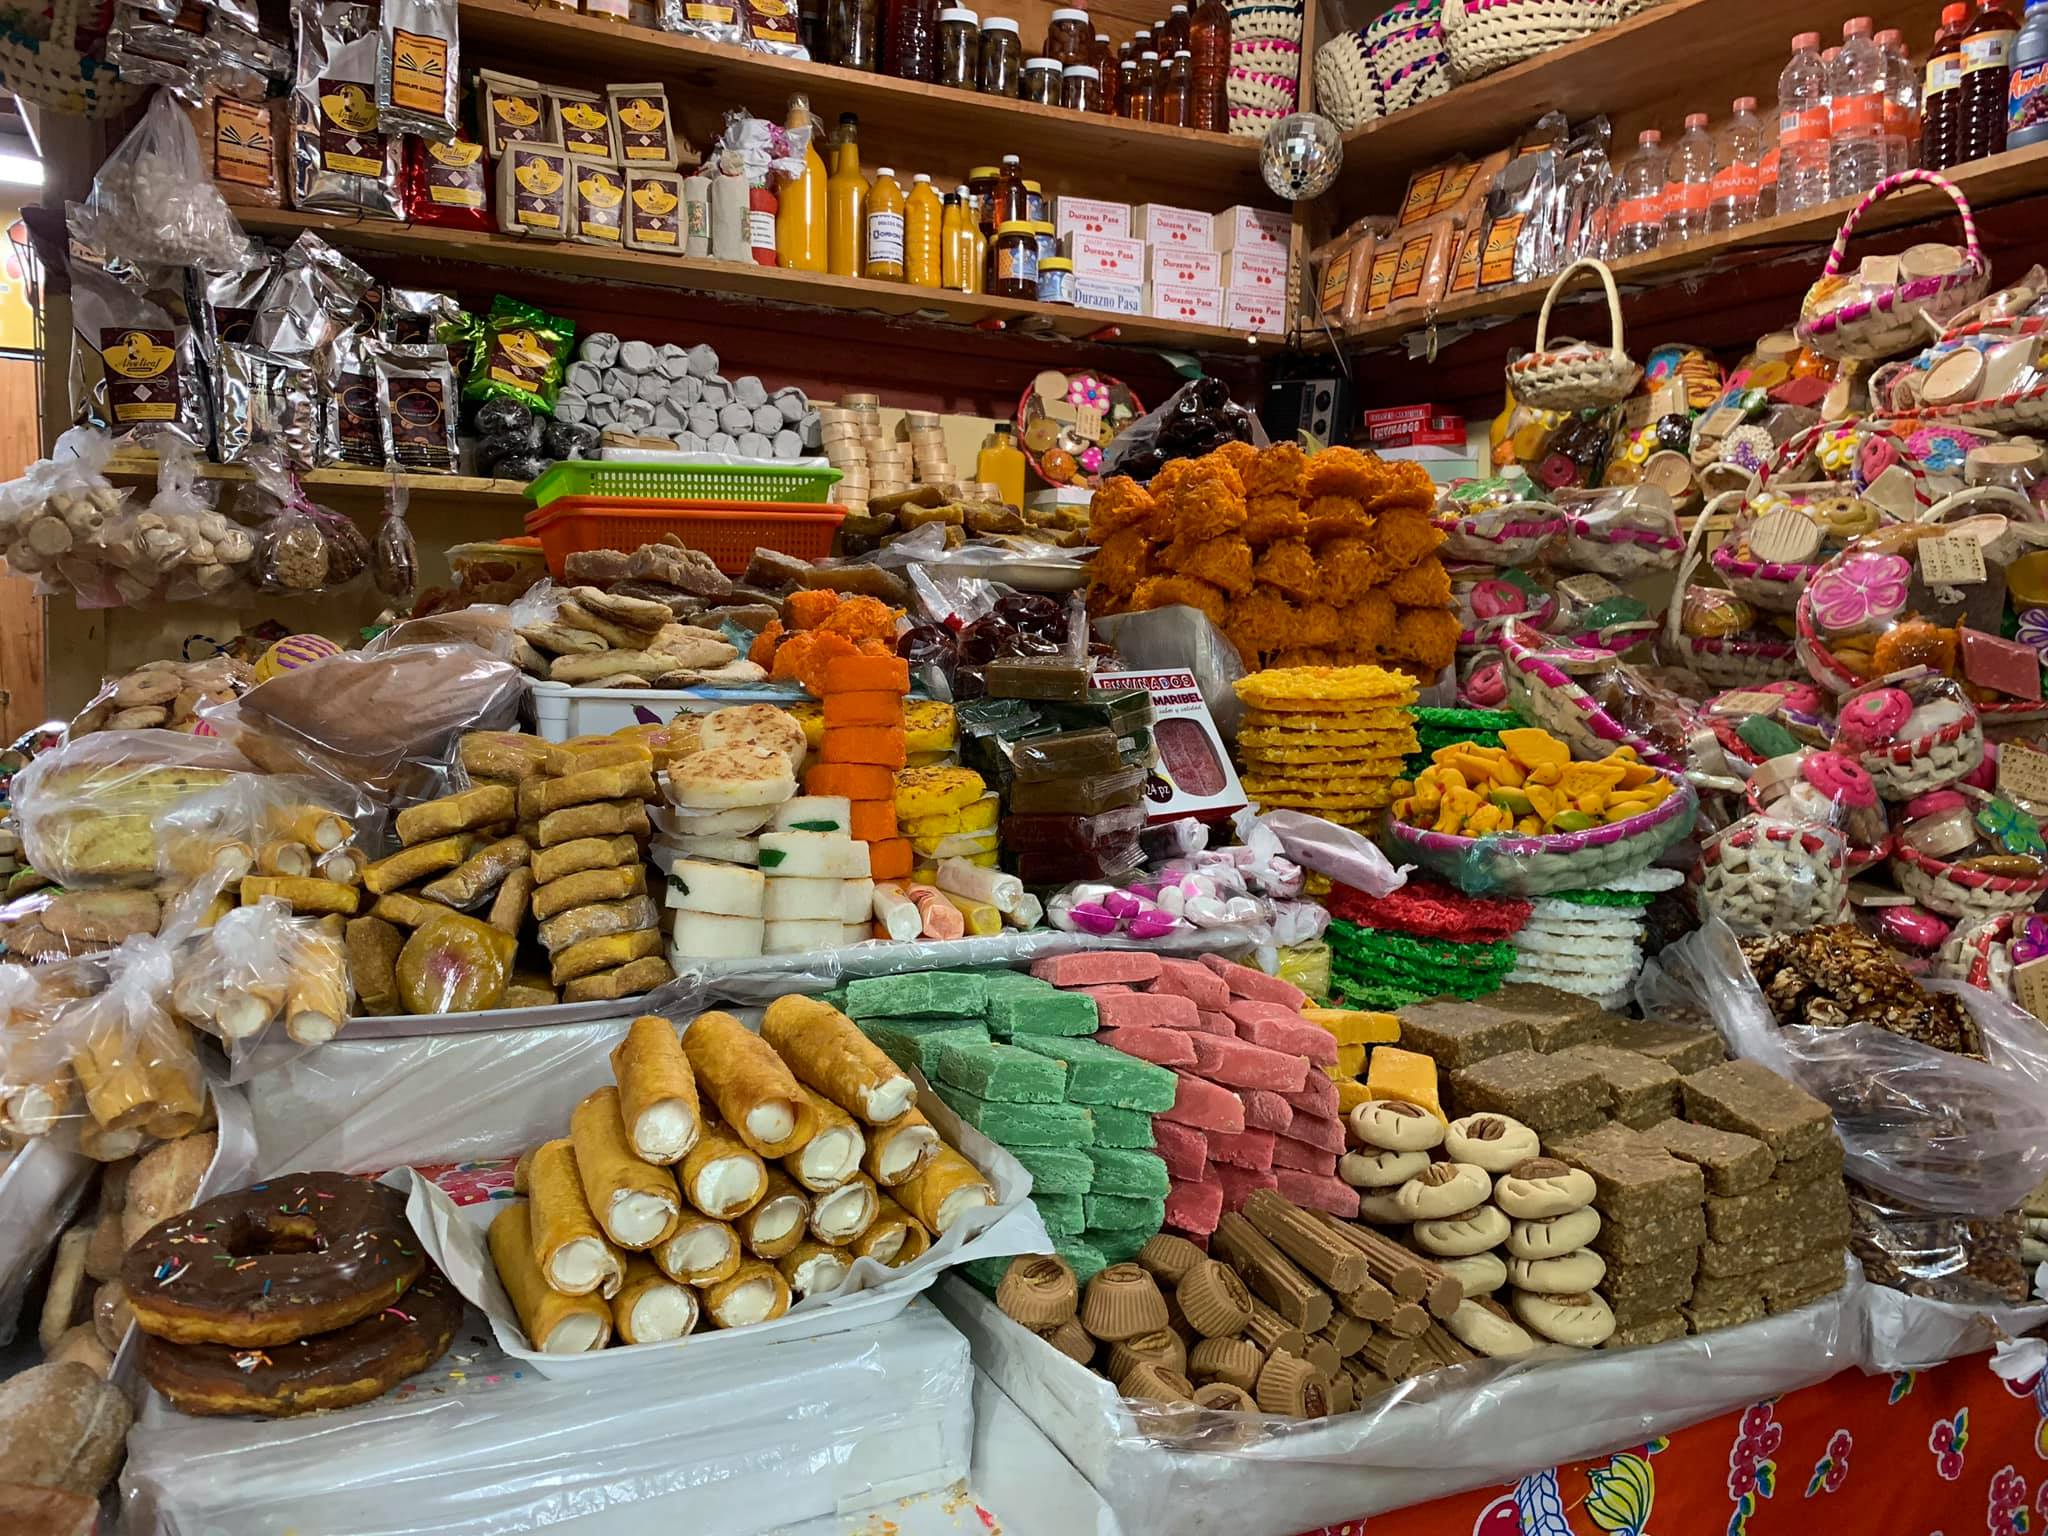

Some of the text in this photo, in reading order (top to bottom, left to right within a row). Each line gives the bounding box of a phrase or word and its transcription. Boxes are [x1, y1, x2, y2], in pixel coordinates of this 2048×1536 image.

[1068, 210, 1119, 224] Durazno Pasa
[1157, 218, 1202, 233] Durazno Pasa
[1083, 244, 1134, 260] Durazno Pasa
[1163, 258, 1210, 271] Durazno Pasa
[1242, 261, 1269, 273] Durazno
[1075, 288, 1138, 311] Durazno Pasa
[1163, 294, 1212, 307] Durazno Pasa
[1235, 302, 1281, 316] Durazno Pasa
[1103, 675, 1192, 690] ENVINADOS
[1152, 693, 1203, 706] MARIBEL
[1145, 783, 1171, 799] 24 pz
